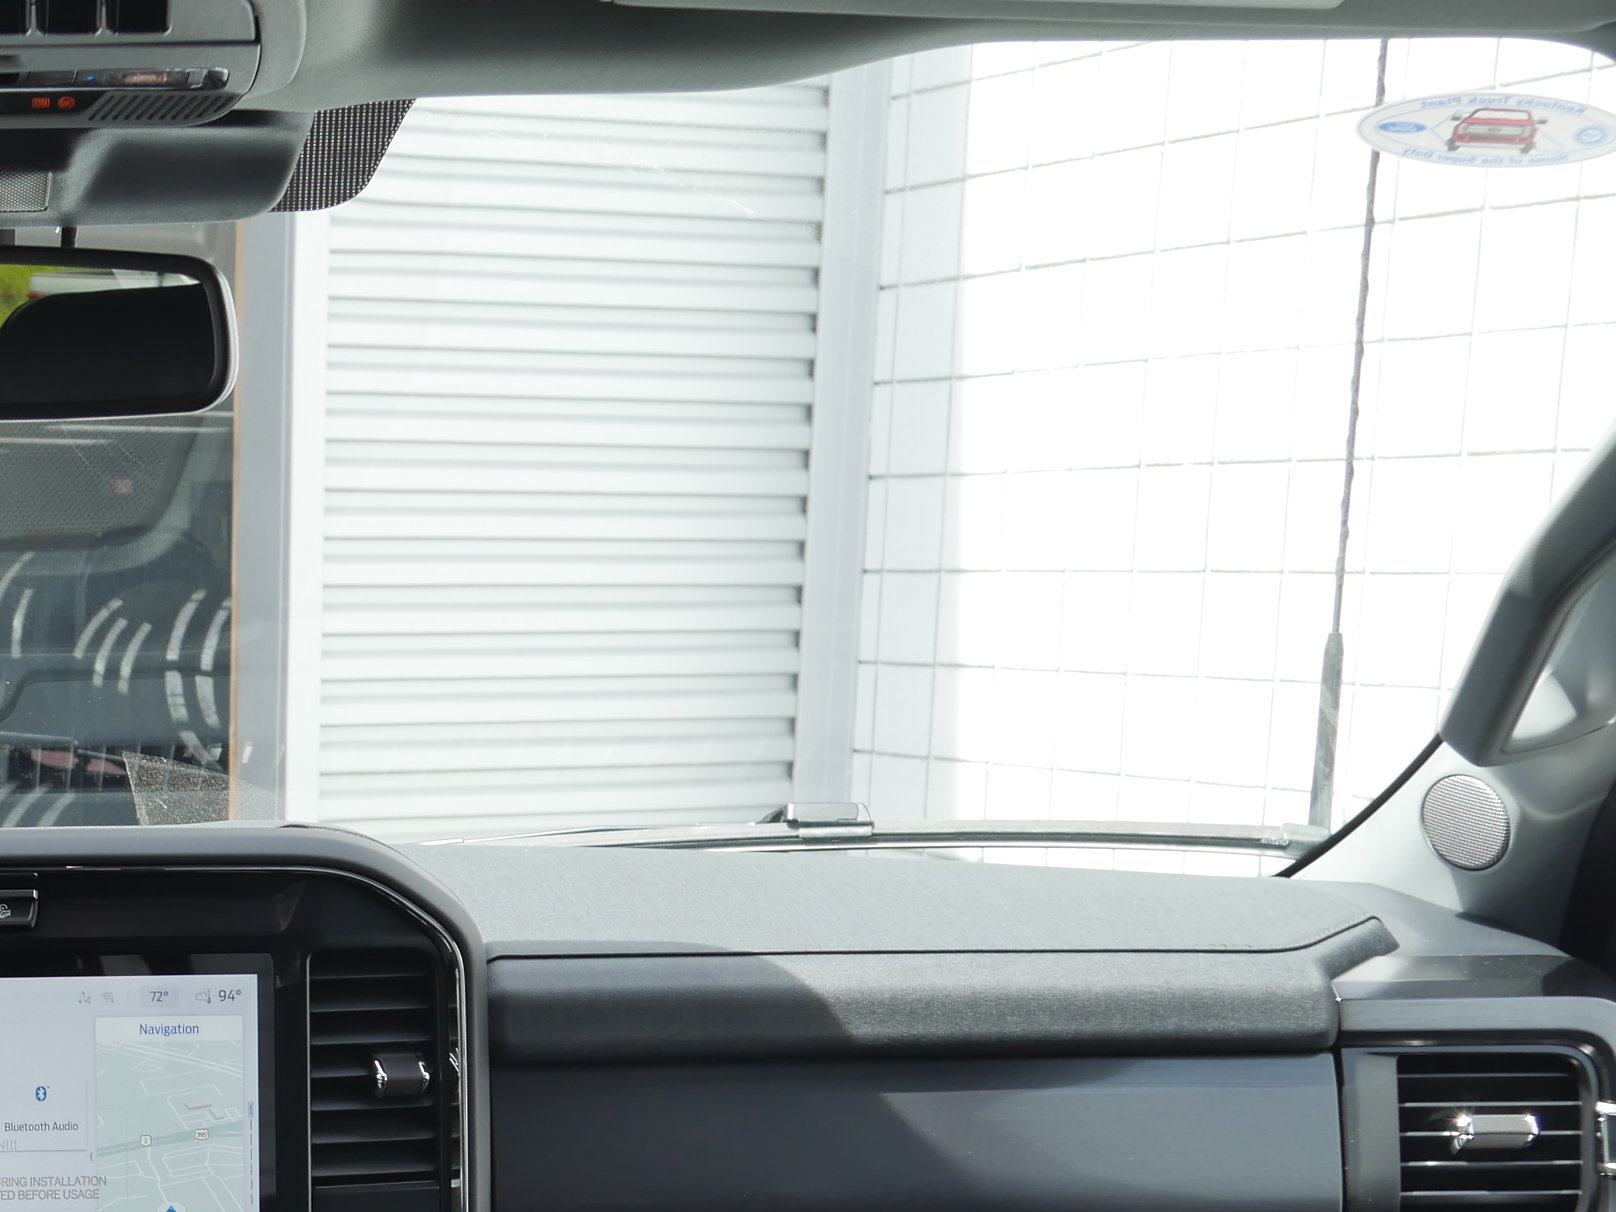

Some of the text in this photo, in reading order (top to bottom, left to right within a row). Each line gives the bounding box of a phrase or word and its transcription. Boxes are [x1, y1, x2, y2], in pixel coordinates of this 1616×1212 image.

[150, 991, 169, 1002] 72°
[218, 989, 242, 1002] 94°
[139, 1023, 200, 1036] Navigation
[4, 1122, 79, 1132] Bluetooth Audio
[29, 1176, 107, 1187] INSTALLATION
[18, 1189, 60, 1200] BEFORE
[62, 1188, 100, 1200] USAGE
